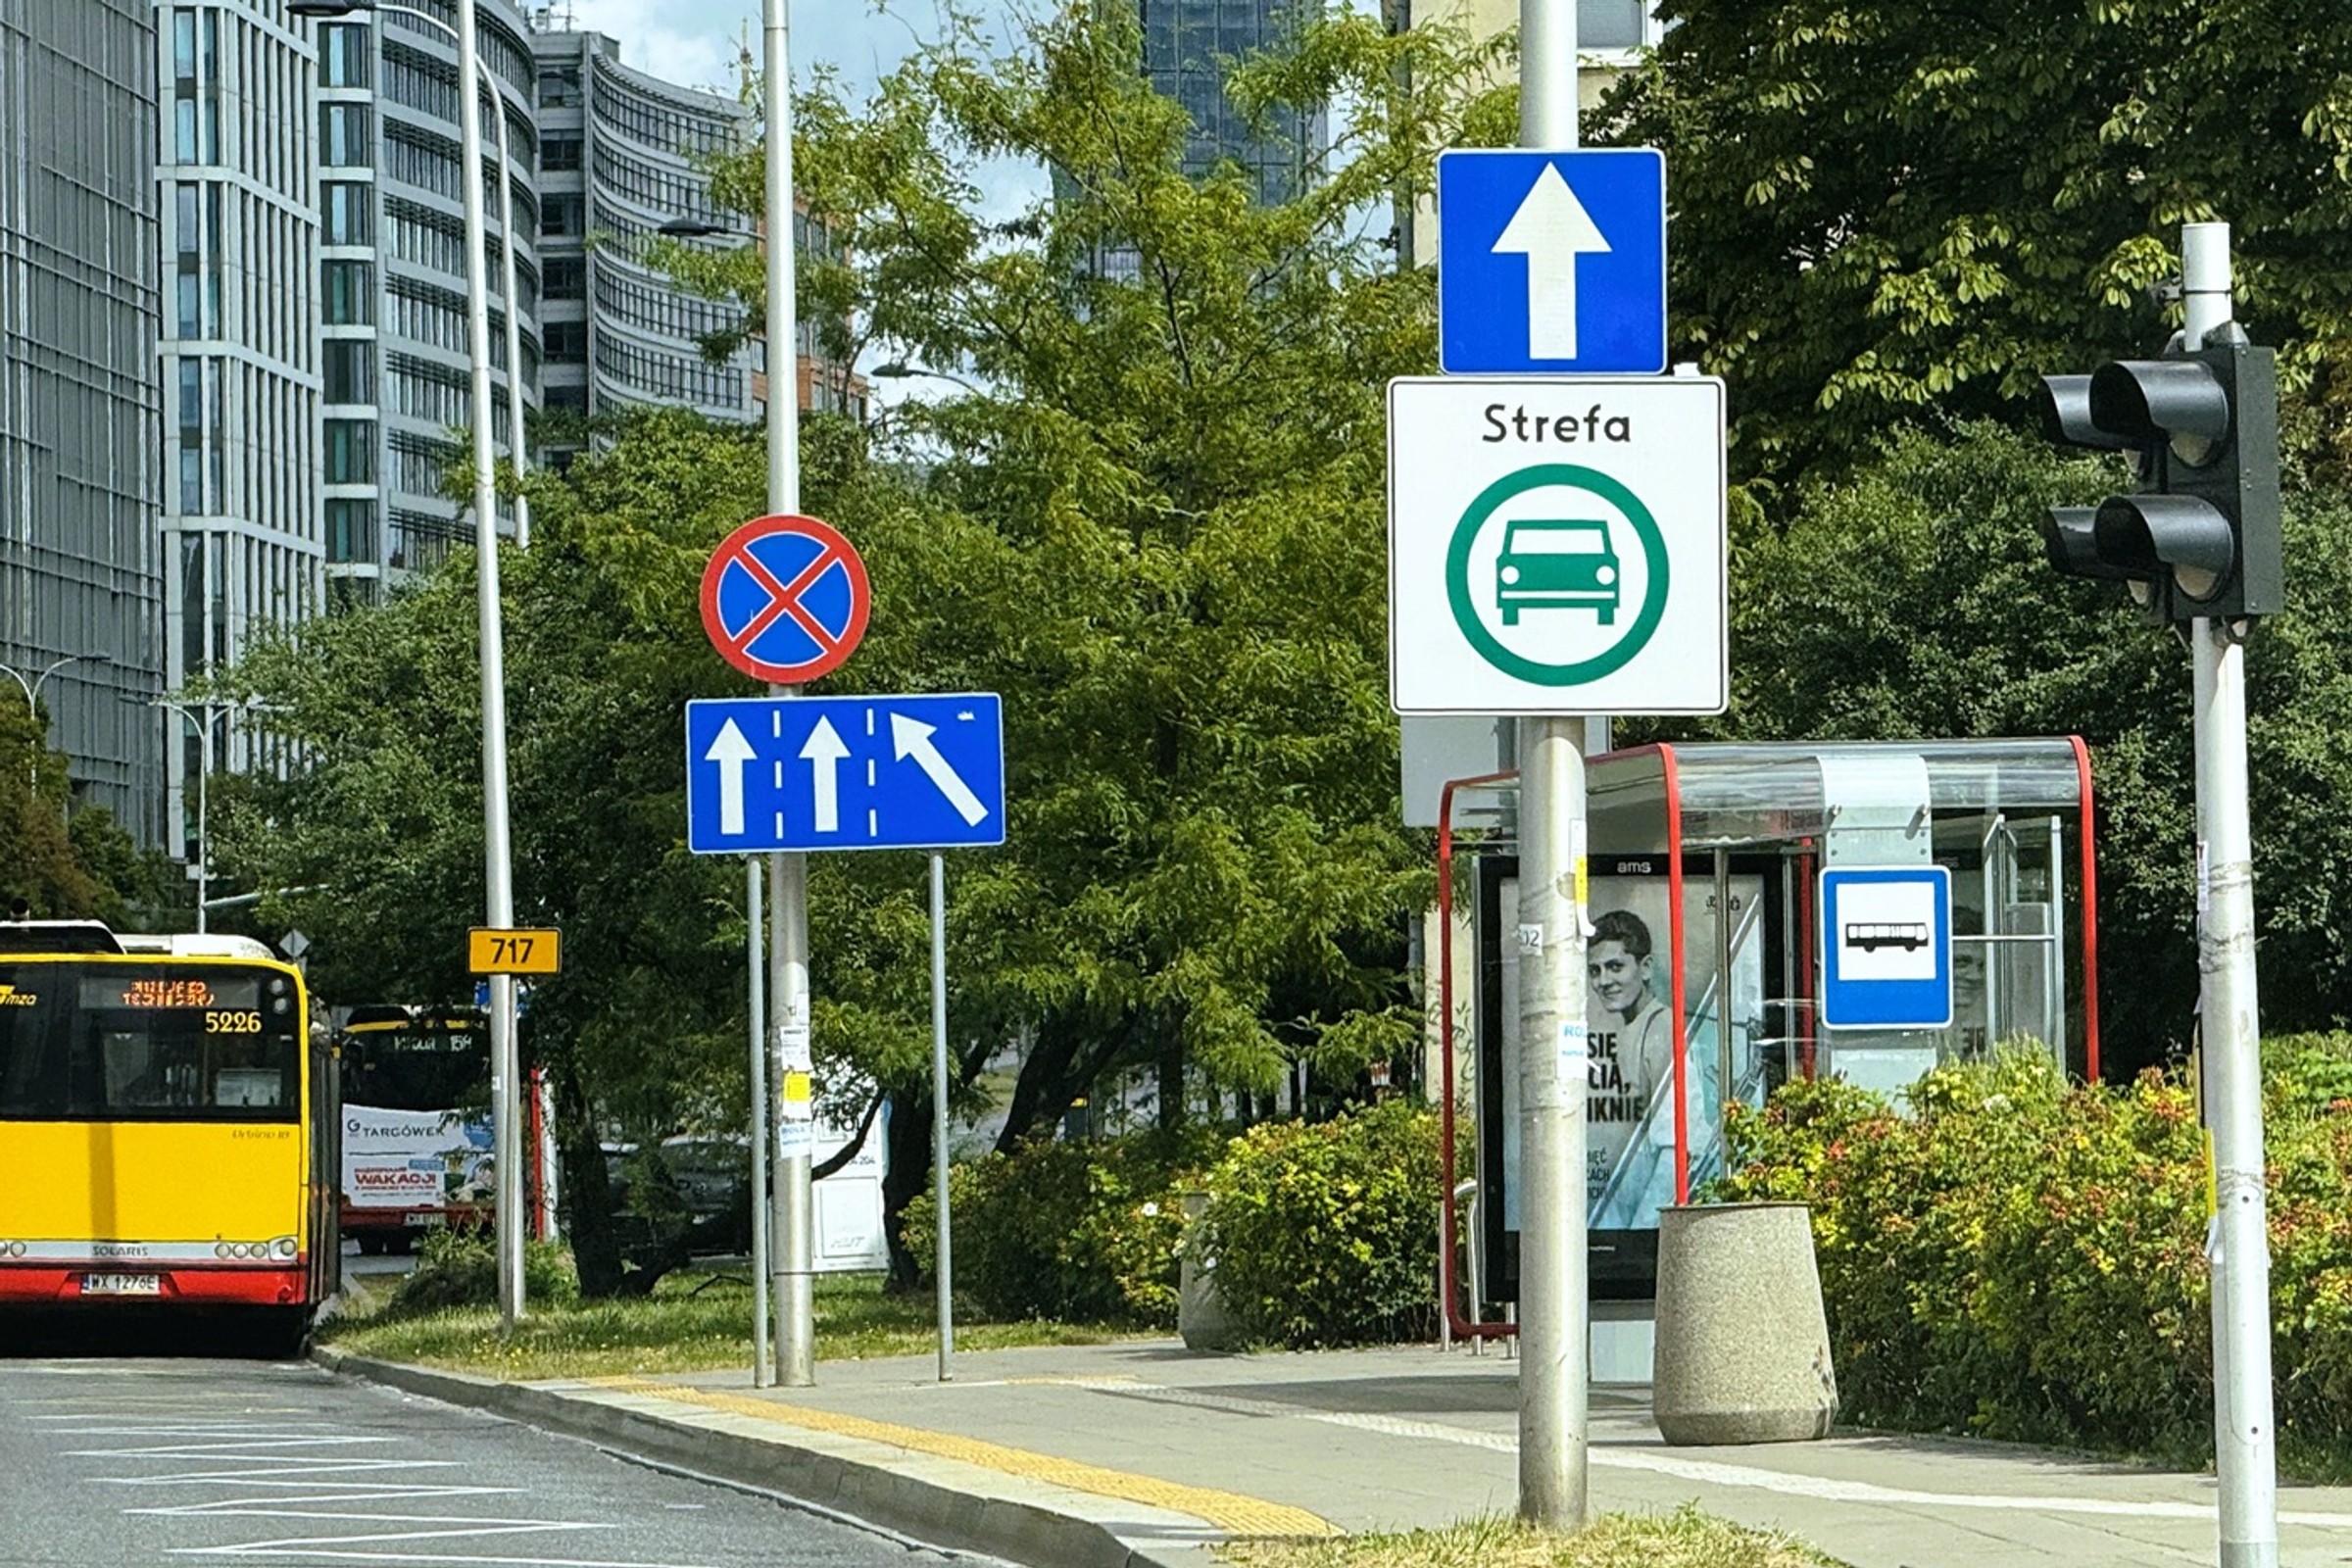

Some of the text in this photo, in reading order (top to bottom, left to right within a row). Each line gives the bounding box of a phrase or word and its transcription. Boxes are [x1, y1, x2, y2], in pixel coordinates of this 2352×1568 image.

[1482, 403, 1631, 443] Strefa
[1617, 861, 1651, 874] ams
[491, 938, 534, 964] 717
[205, 1011, 263, 1033] 5226
[1587, 1032, 1618, 1062] SIĘ
[1588, 1063, 1631, 1094] CIĄ,
[1587, 1096, 1643, 1123] IKNIE
[362, 1124, 445, 1138] TARGÓWEK
[92, 1246, 149, 1256] SOLARIS
[91, 1274, 157, 1290] WX 1276E
